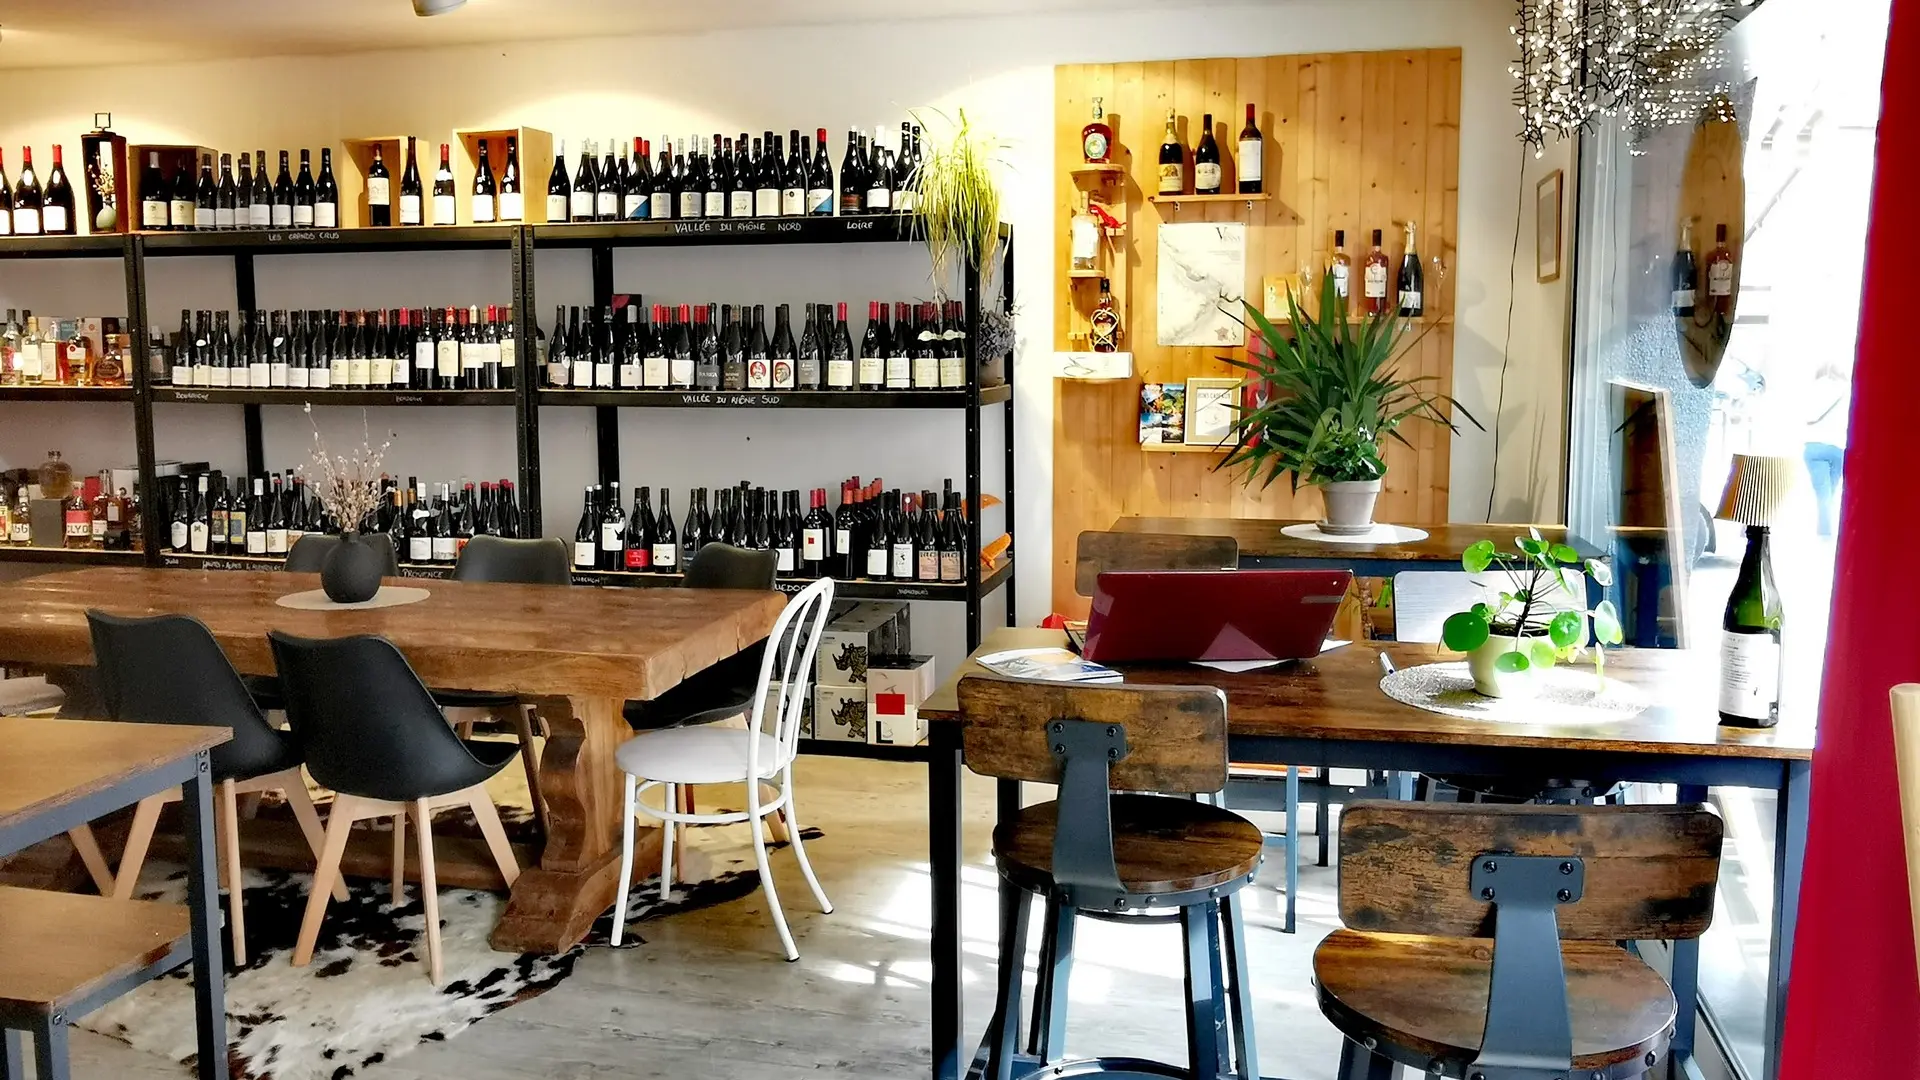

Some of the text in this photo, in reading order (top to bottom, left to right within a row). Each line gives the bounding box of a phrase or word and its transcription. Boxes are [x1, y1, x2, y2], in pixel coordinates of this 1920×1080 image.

[675, 220, 801, 233] VALLÉE DU RHÔNE NORD
[268, 231, 340, 241] LES GRANDS CRUS
[682, 393, 711, 403] VALLÉE
[716, 396, 727, 404] DU
[761, 394, 780, 404] SUD
[402, 568, 444, 578] PROVENCE
